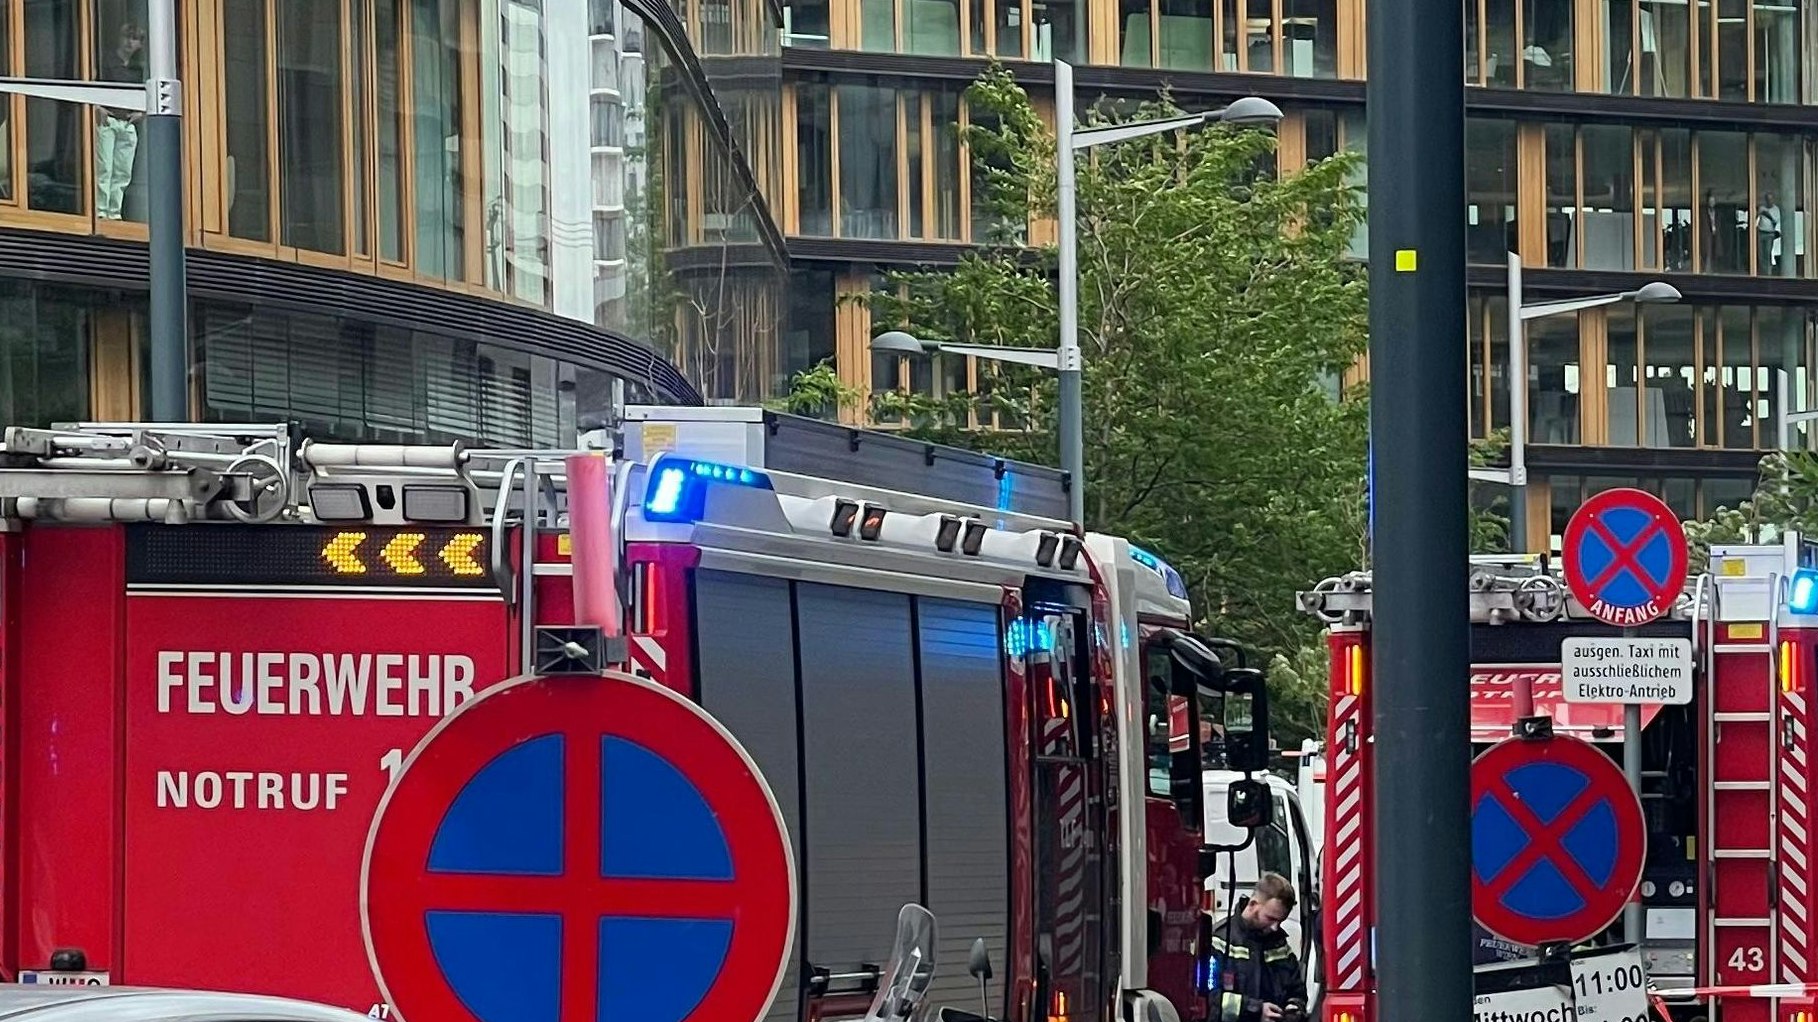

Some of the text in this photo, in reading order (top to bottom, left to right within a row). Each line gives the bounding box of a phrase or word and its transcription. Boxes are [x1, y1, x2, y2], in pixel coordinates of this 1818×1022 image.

[1590, 600, 1660, 624] ANFANG
[1573, 645, 1681, 661] ausgen. Taxi mit
[1573, 664, 1682, 680] ausschließlichem
[157, 651, 477, 718] FEUERWEHR
[1578, 682, 1677, 699] Elektro-Antrieb
[156, 770, 348, 810] NOTRUF
[1727, 947, 1764, 972] 43
[1575, 964, 1643, 997] 11:00
